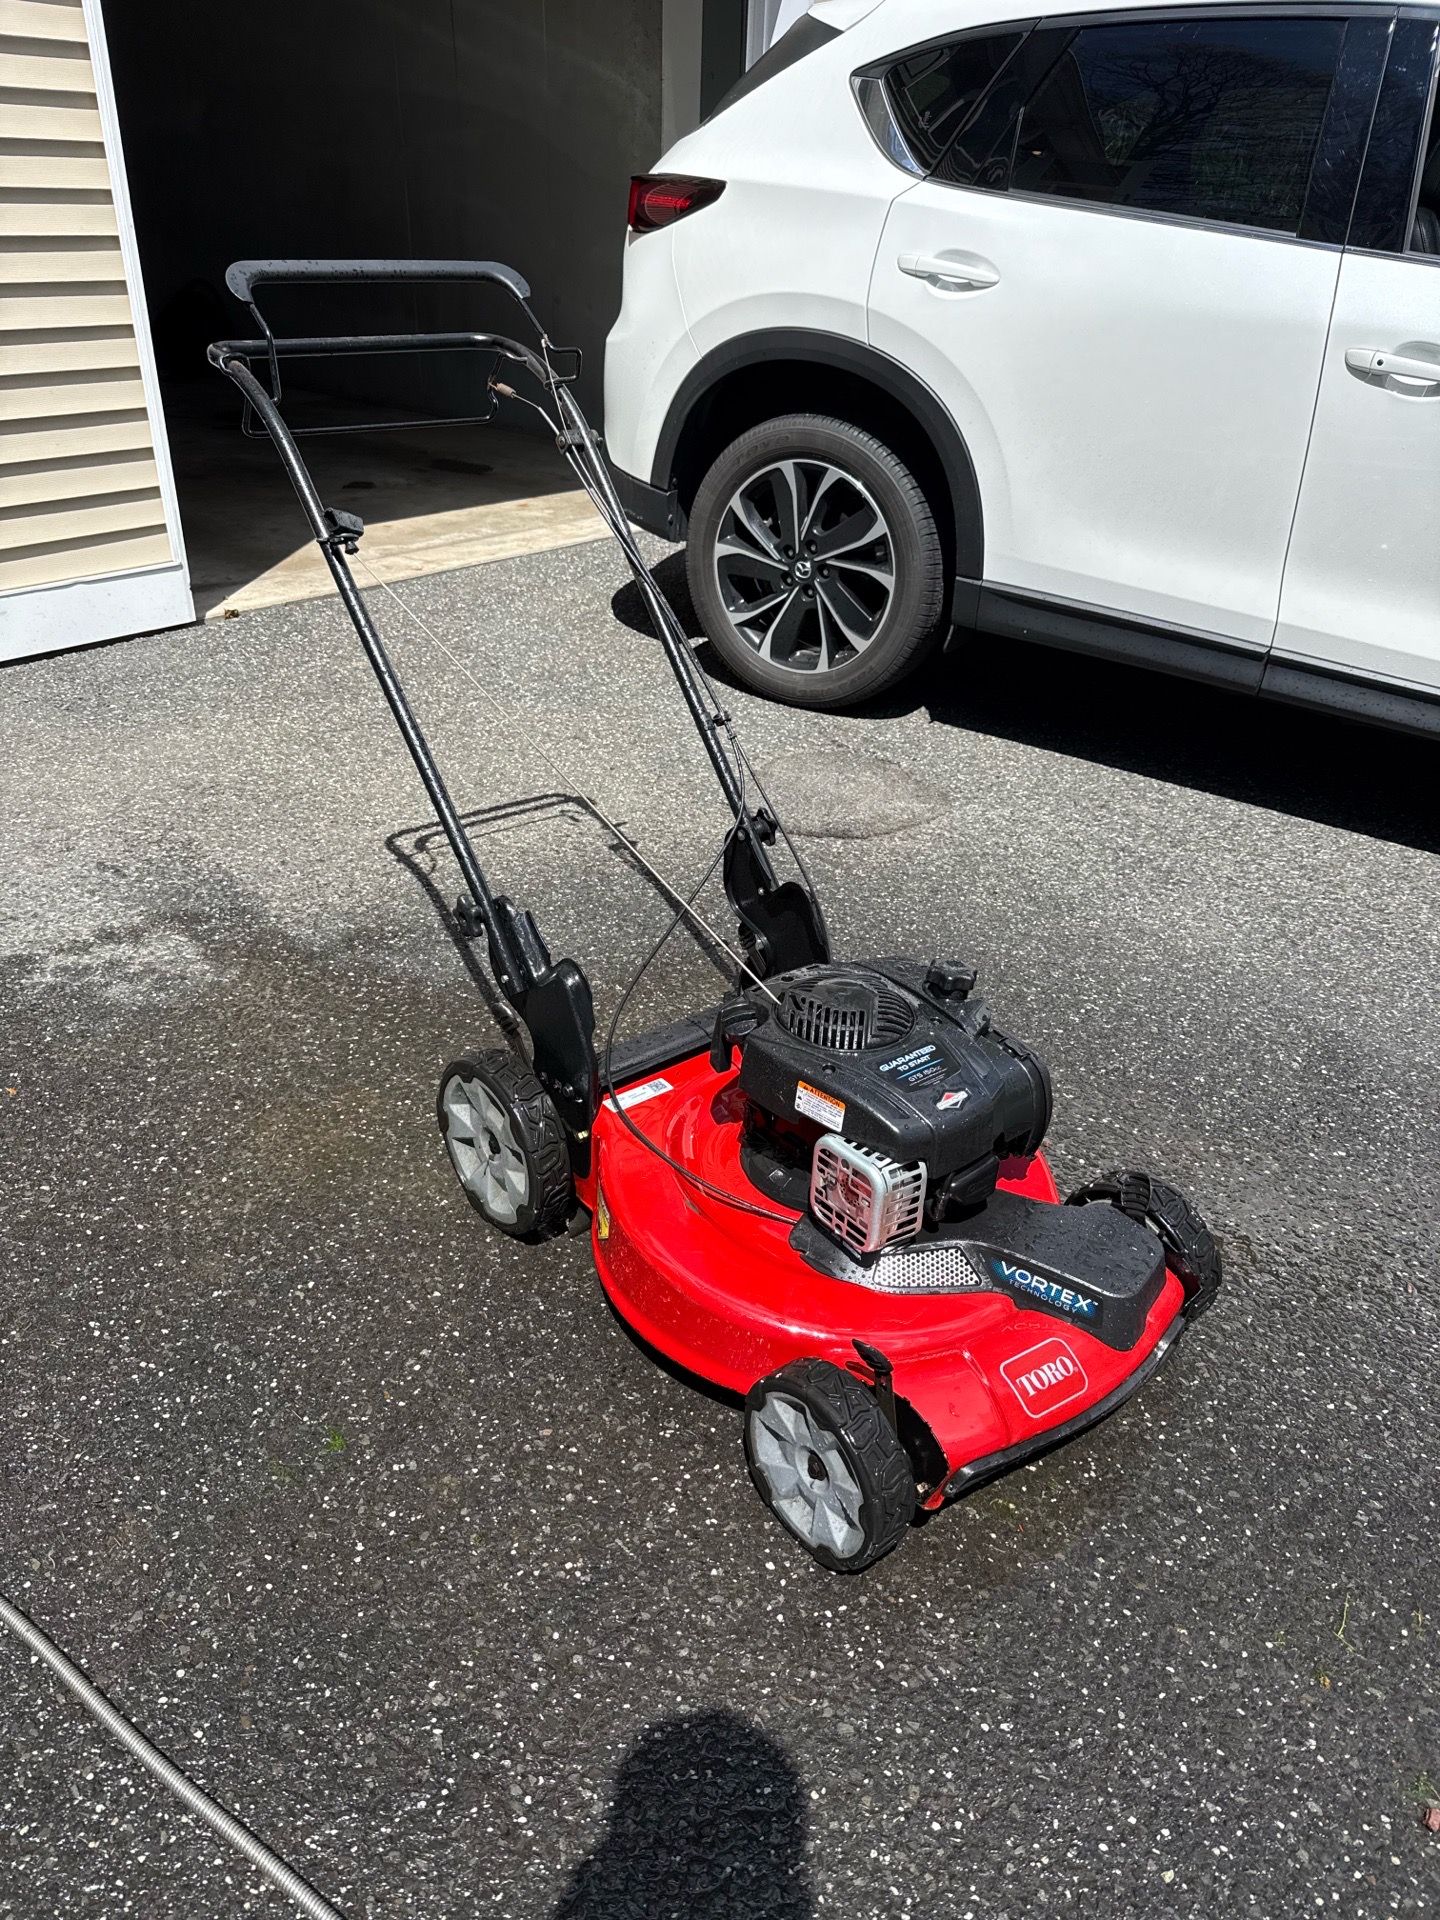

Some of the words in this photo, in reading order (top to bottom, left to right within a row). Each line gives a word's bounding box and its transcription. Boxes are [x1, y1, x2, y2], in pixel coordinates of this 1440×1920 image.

[879, 1044, 936, 1072] GUARANTEED
[897, 1064, 909, 1072] TO
[909, 1054, 931, 1068] START
[908, 1072, 923, 1082] GTS
[810, 1088, 840, 1108] ATTENTION
[1001, 1261, 1093, 1312] VORTEX
[1009, 1279, 1078, 1314] TECHNOLOGY
[1016, 1355, 1074, 1397] TORO
